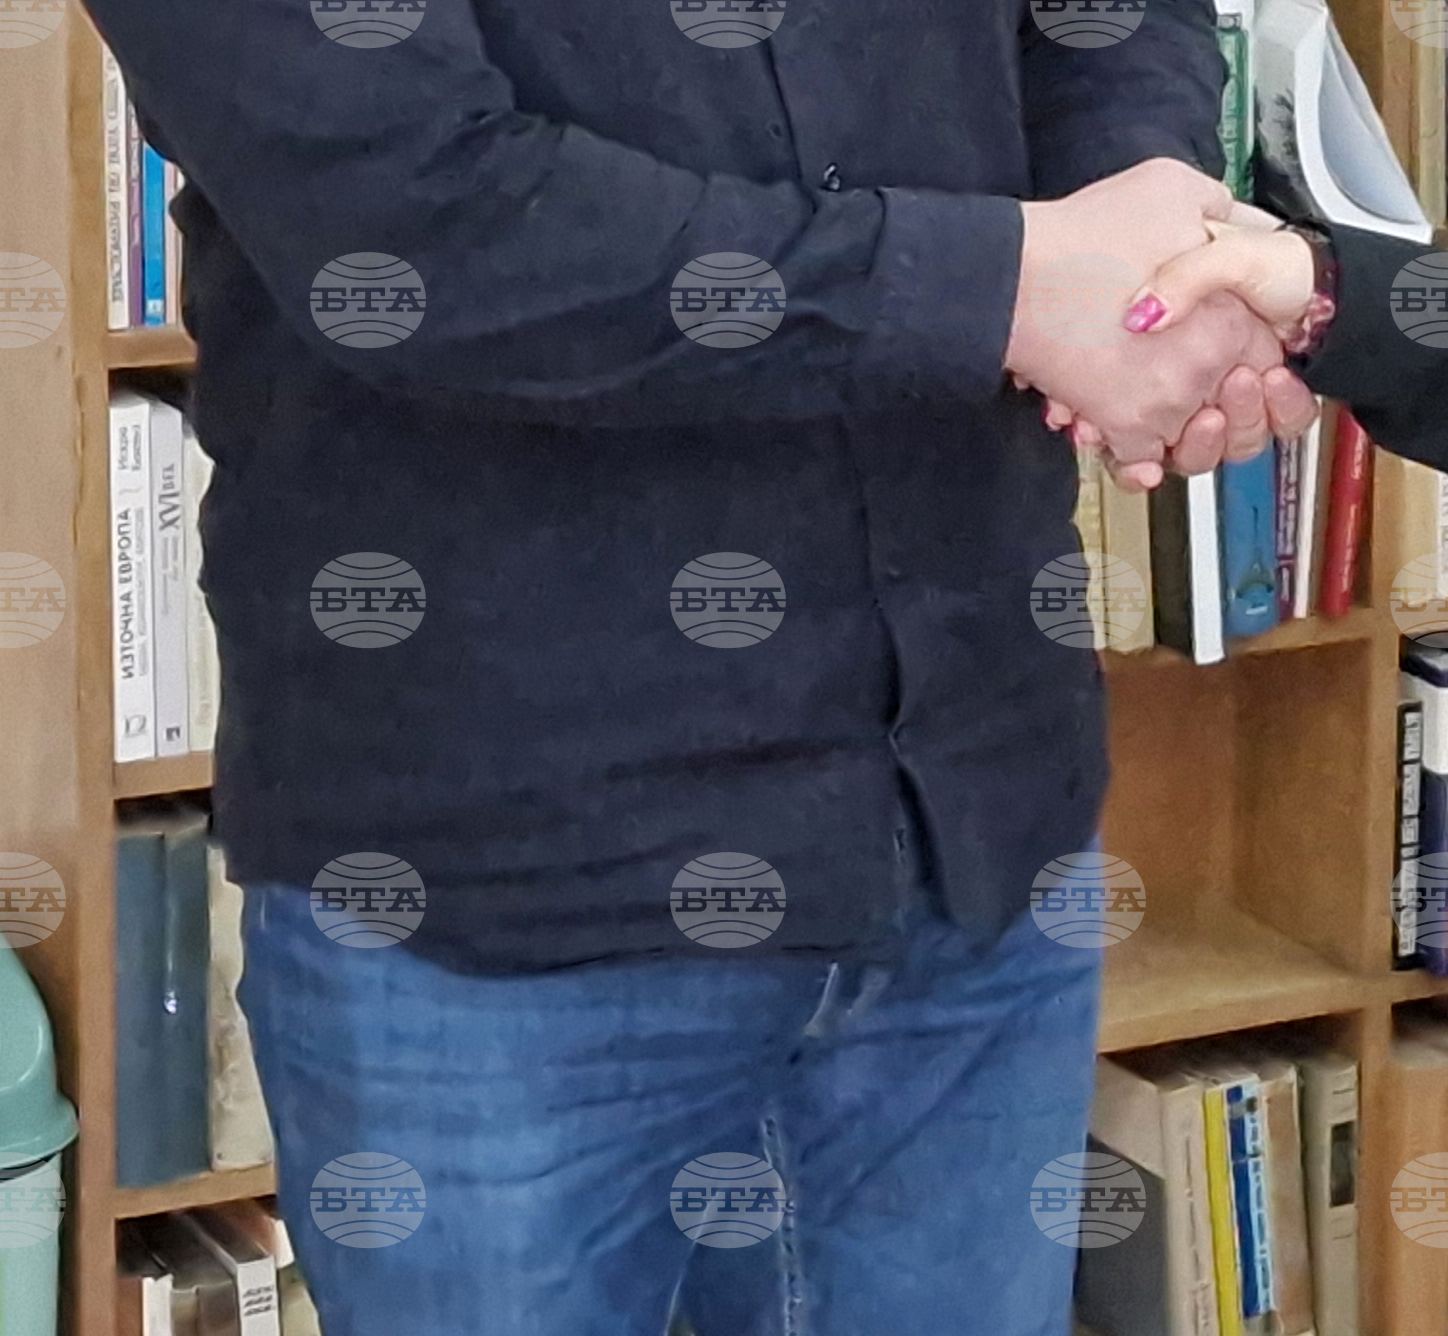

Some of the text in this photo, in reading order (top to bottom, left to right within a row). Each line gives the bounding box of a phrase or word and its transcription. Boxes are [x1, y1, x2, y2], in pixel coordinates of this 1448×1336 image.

[157, 491, 182, 533] XVI
[116, 509, 134, 680] ИЗТОЧНА ЕВРОПА
